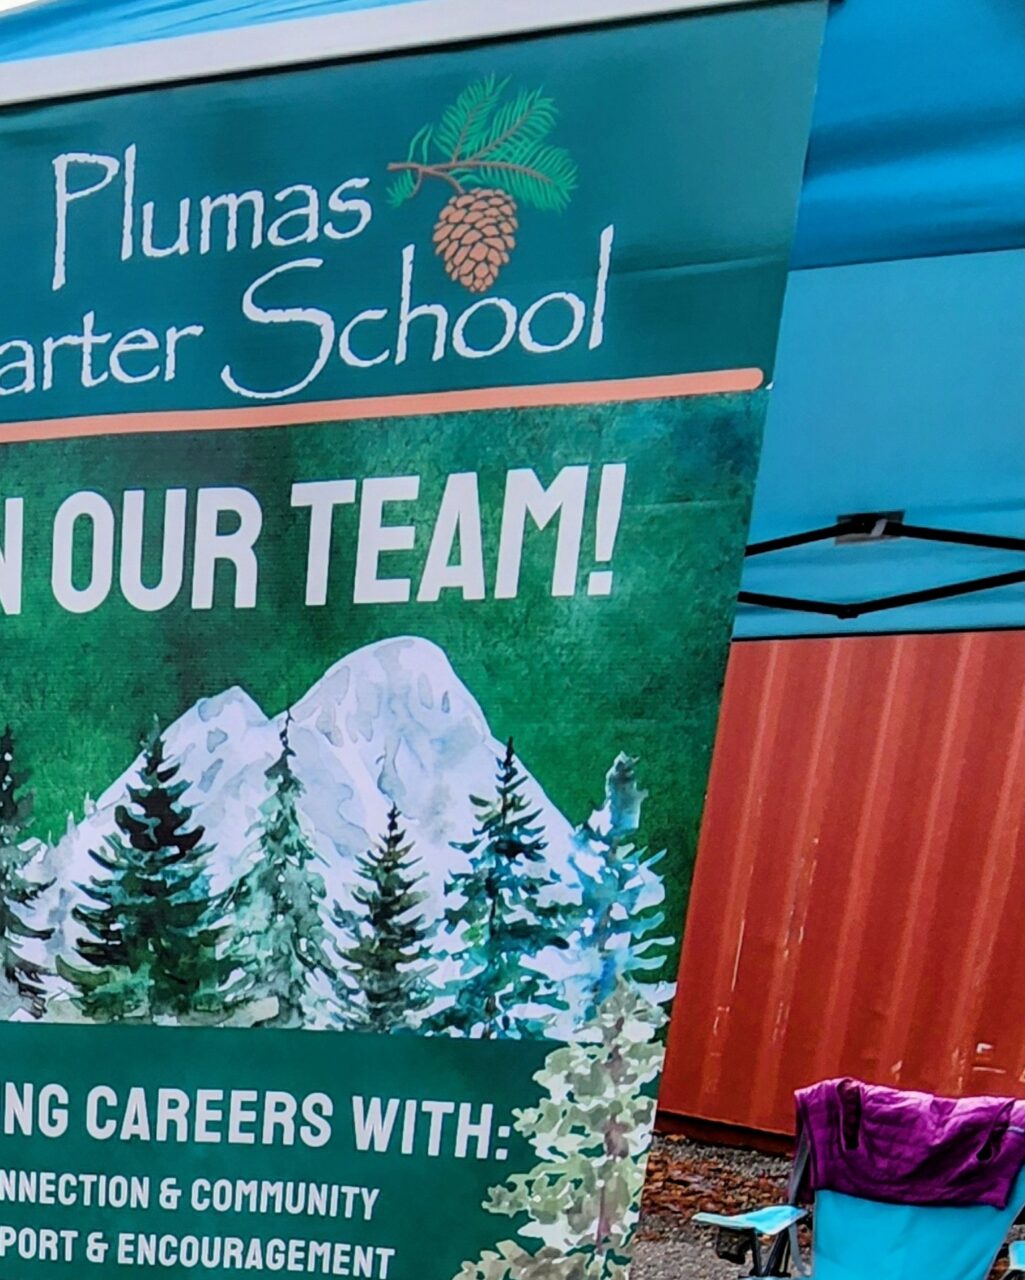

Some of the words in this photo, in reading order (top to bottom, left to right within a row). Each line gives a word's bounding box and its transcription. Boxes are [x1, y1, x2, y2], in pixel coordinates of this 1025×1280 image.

[50, 144, 373, 291] Plumas
[222, 224, 614, 400] School
[50, 485, 265, 613] OUR
[291, 463, 628, 605] TEAM!
[85, 1085, 333, 1147] CAREERS
[352, 1096, 510, 1160] WITH:
[159, 1176, 181, 1208] &
[190, 1179, 379, 1220] COMMUNITY
[86, 1231, 109, 1263] &
[117, 1232, 395, 1280] ENCOURAGEMENT
